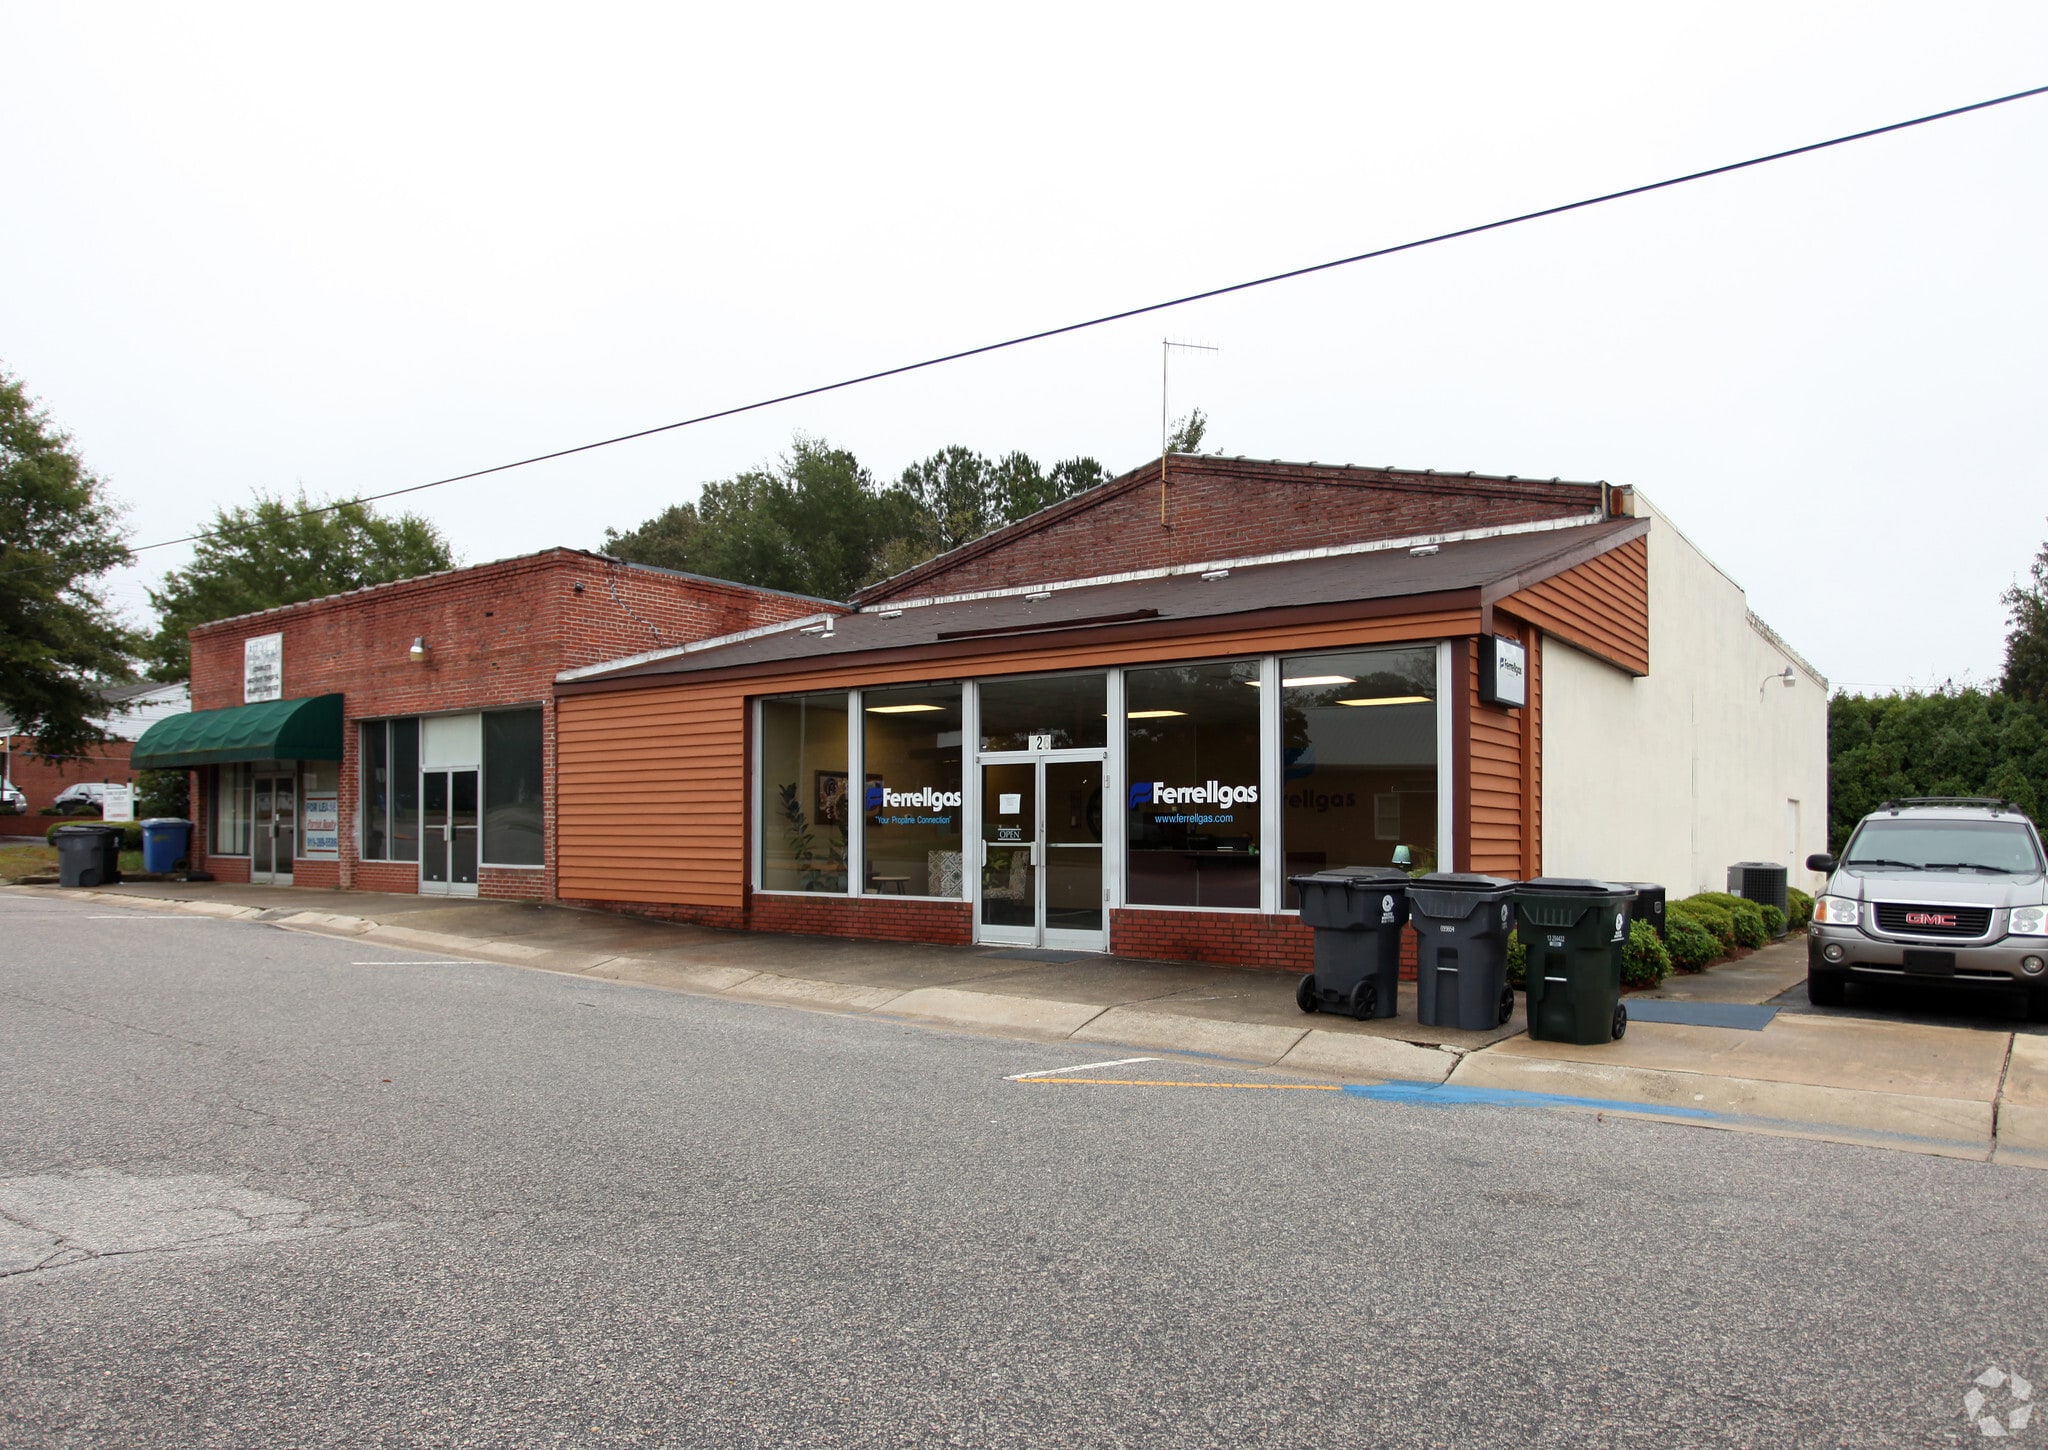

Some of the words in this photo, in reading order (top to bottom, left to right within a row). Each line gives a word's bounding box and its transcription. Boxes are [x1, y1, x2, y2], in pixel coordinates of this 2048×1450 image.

[882, 786, 962, 813] Ferrellgas
[1153, 780, 1258, 810] Ferrellgas
[306, 802, 318, 813] FOR
[319, 802, 337, 813] LEASE
[891, 816, 915, 825] Propane
[1154, 813, 1234, 825] www.ferrellgas.com
[999, 830, 1020, 839] OPEN
[1906, 911, 1956, 926] GMC
